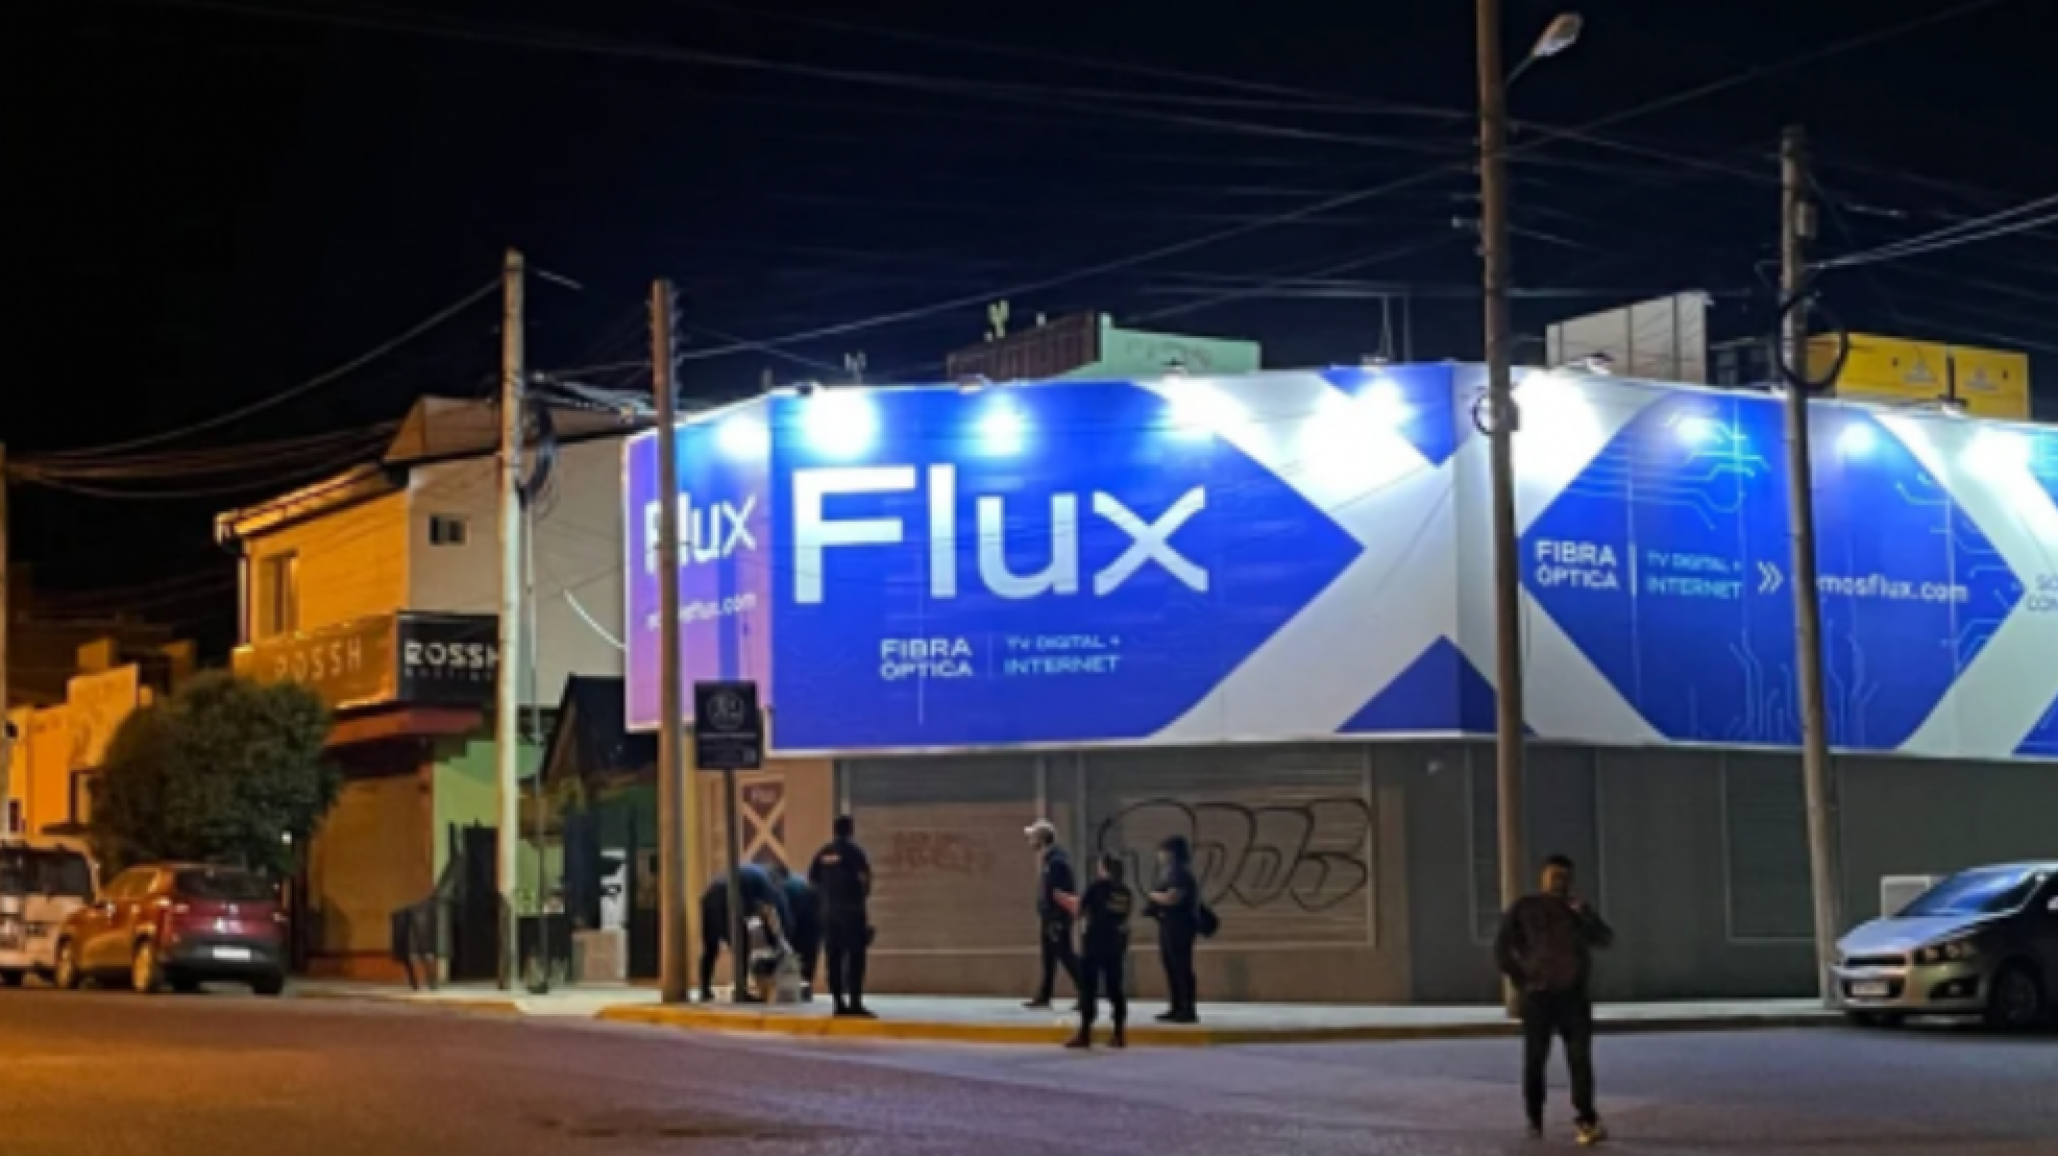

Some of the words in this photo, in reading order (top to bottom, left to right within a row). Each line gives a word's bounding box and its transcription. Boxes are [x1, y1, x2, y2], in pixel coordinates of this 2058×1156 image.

[644, 491, 757, 575] Flux
[792, 464, 1209, 605] Flux
[1535, 540, 1616, 567] FIBRA
[1647, 575, 1743, 599] INTERNET
[1810, 573, 1968, 602] mosflux.com
[880, 638, 972, 659] FIBRA
[1004, 655, 1121, 675] INTERNET
